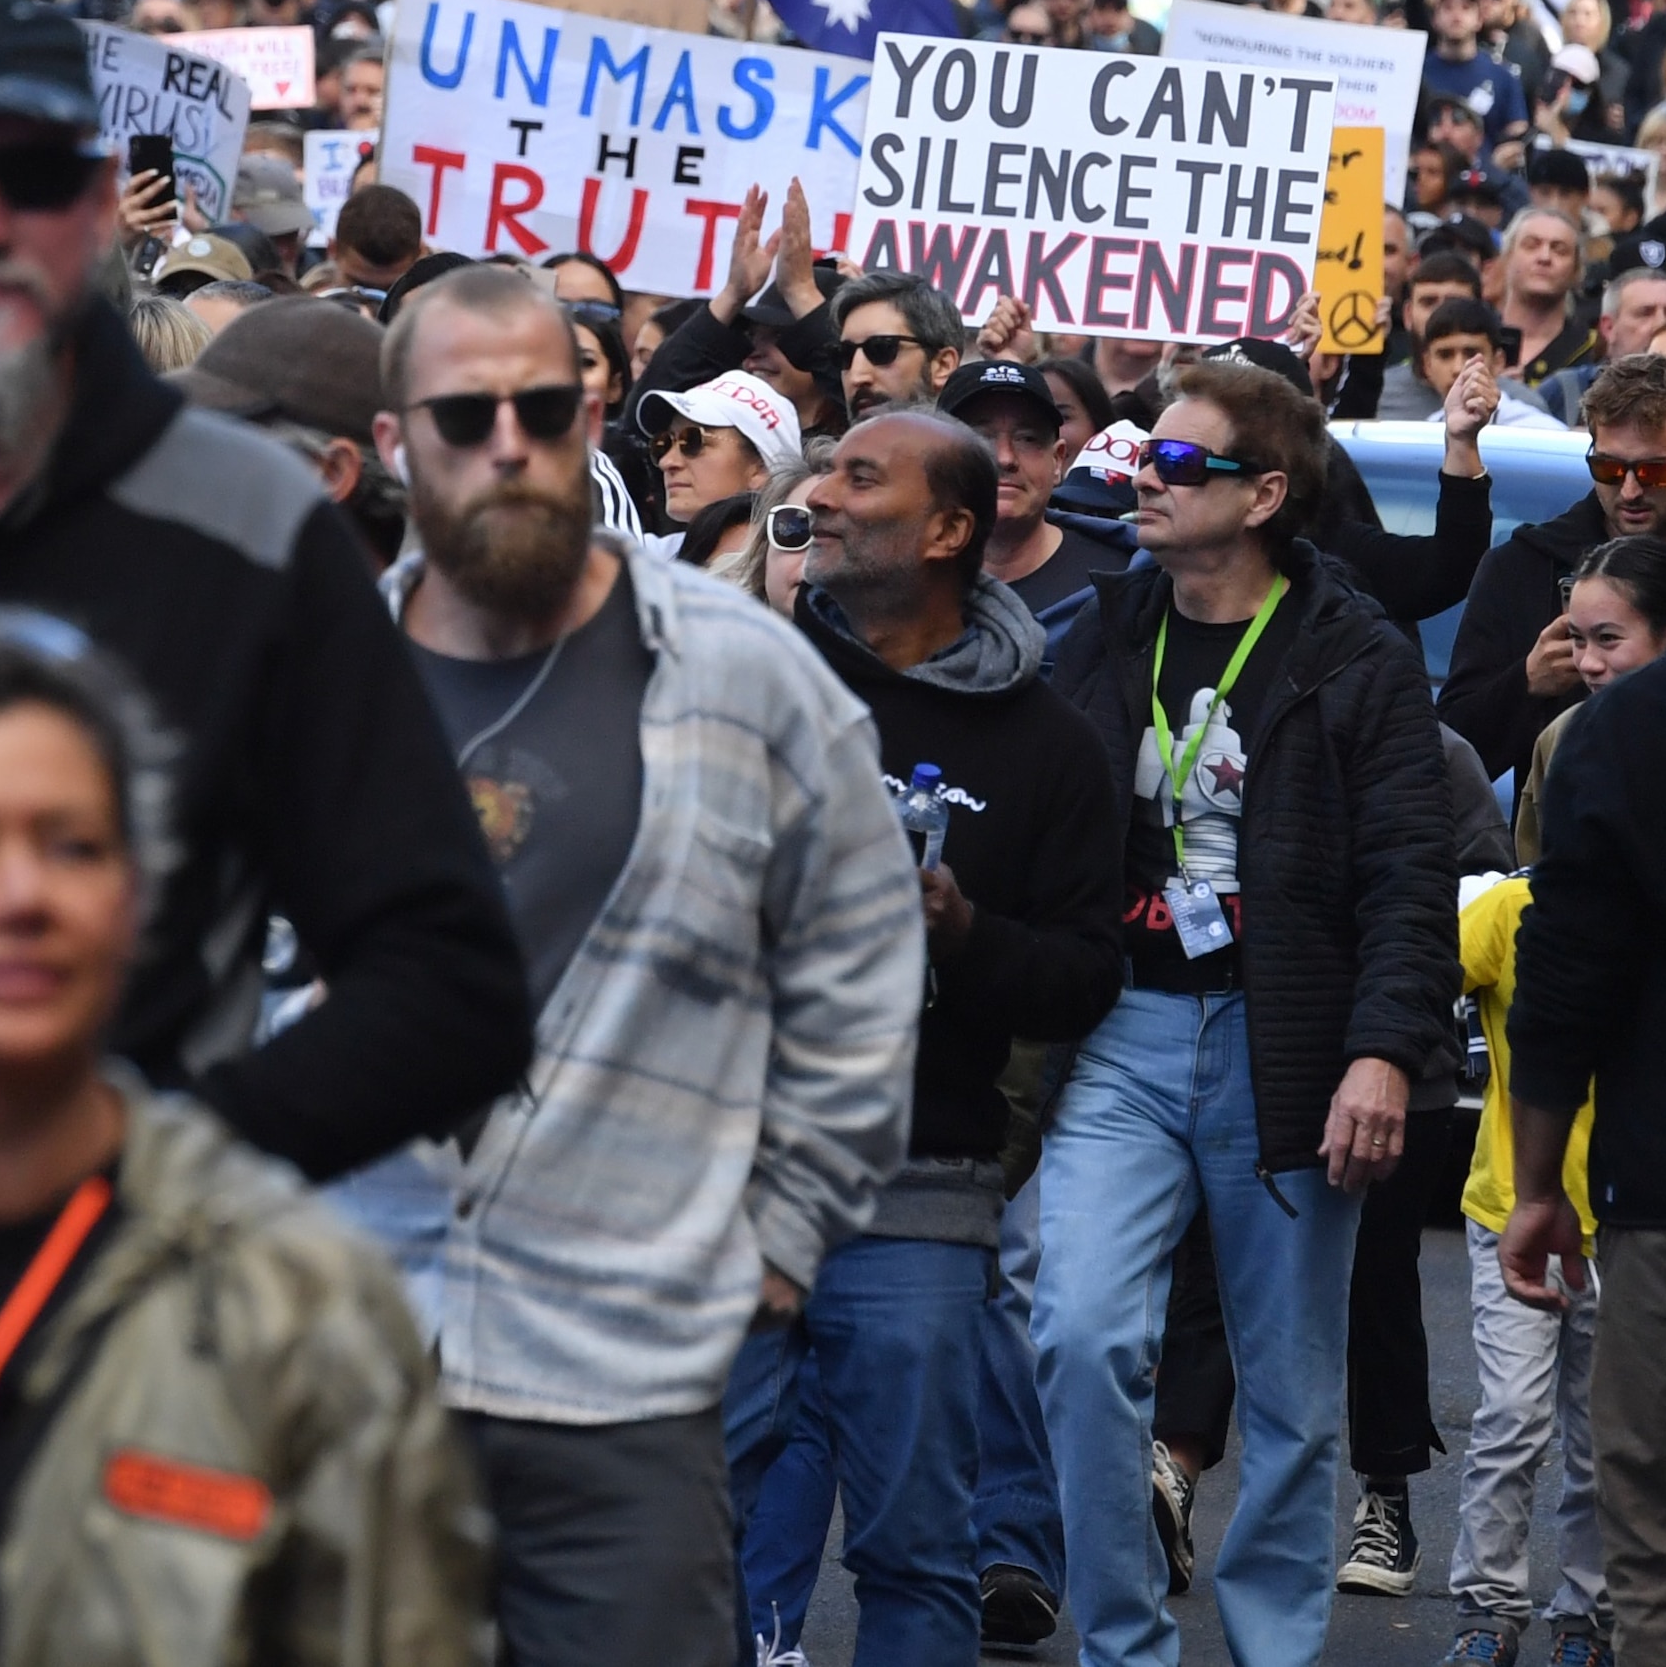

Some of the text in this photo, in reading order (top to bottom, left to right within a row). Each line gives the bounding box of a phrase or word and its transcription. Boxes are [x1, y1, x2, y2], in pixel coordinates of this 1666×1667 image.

[85, 30, 235, 122] HE REAL
[419, 2, 871, 158] UNMASK
[884, 41, 1333, 153] YOU CAN'T
[1298, 49, 1322, 63] THE
[1329, 53, 1396, 73] SOLDIERS
[508, 119, 705, 186] THE
[862, 133, 1319, 244] SILENCE THE
[862, 218, 1308, 341] AWAKENED
